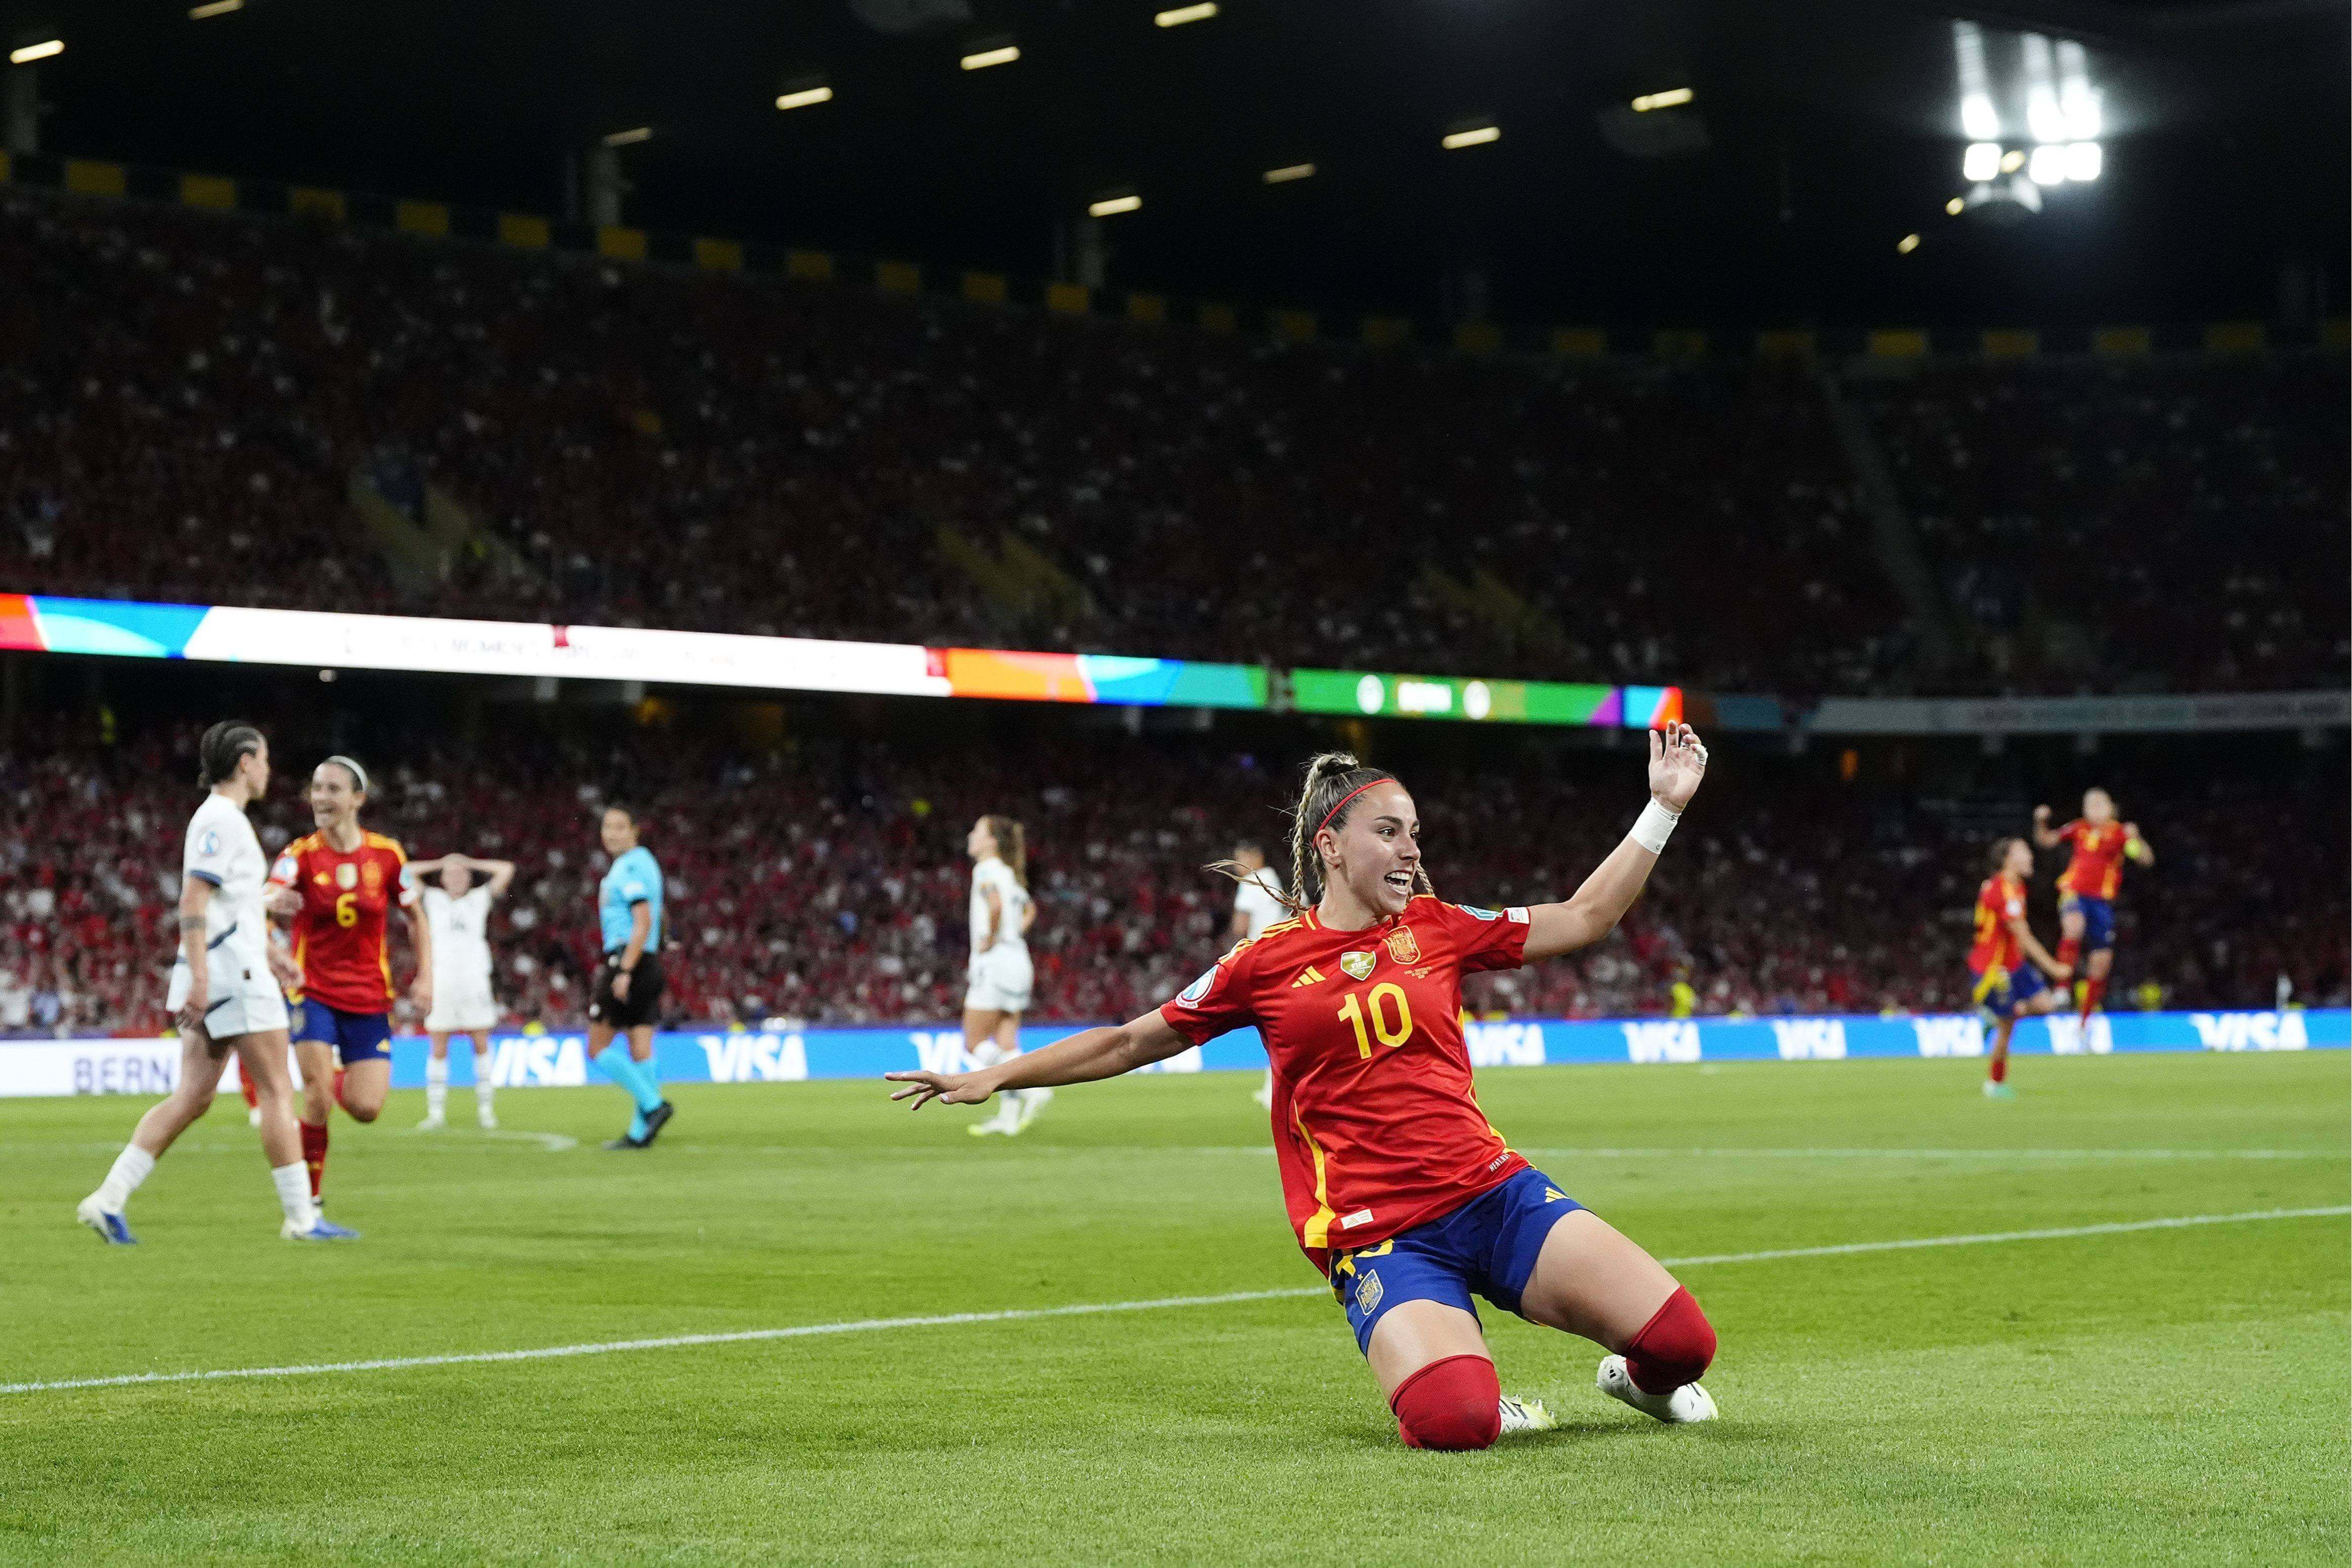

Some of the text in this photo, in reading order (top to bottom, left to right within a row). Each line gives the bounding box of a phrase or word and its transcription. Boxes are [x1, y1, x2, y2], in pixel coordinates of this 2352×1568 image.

[336, 892, 358, 928] 6
[1337, 982, 1413, 1060] 10
[1774, 1020, 1847, 1060] VISA
[2189, 1013, 2308, 1051] VISA
[698, 1034, 808, 1083] VISA
[1622, 1022, 1701, 1063] VISA
[74, 1057, 172, 1093] BERN
